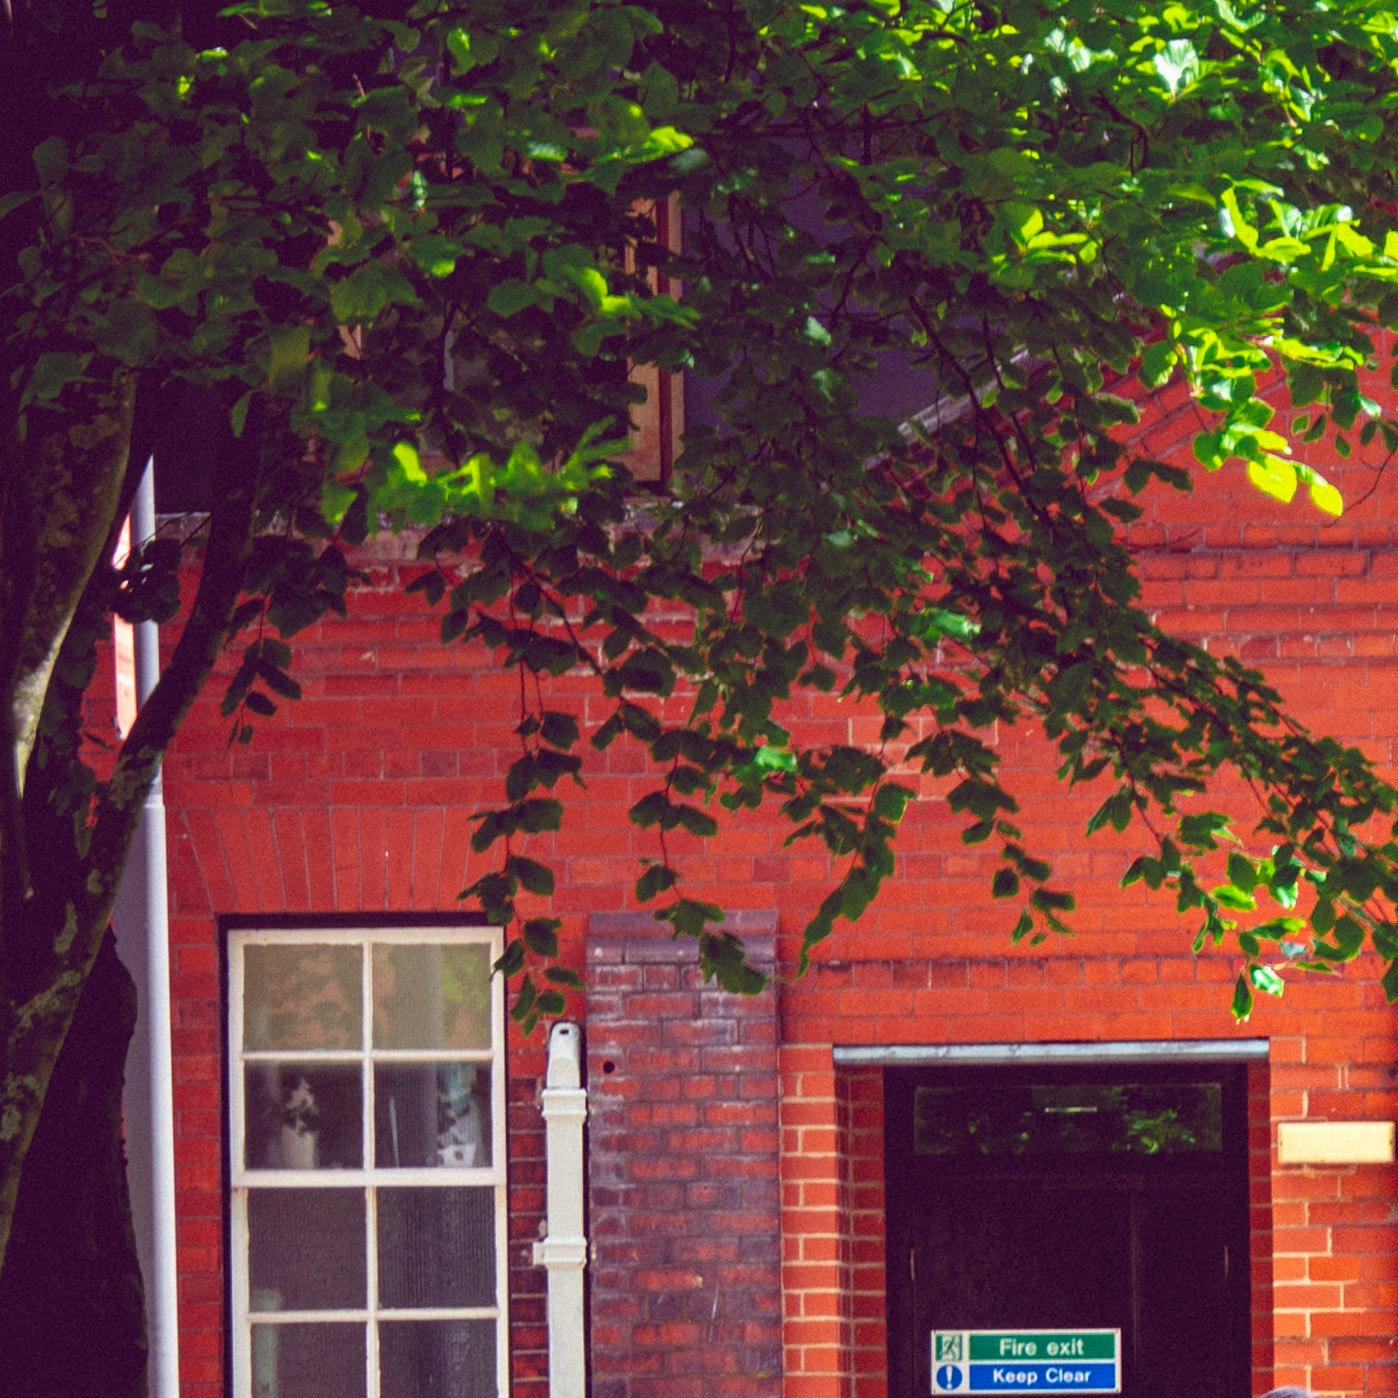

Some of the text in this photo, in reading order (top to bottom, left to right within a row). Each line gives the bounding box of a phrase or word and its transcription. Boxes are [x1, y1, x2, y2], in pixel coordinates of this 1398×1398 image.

[999, 1336, 1084, 1356] Fire exit
[992, 1367, 1091, 1386] Keep Clear
